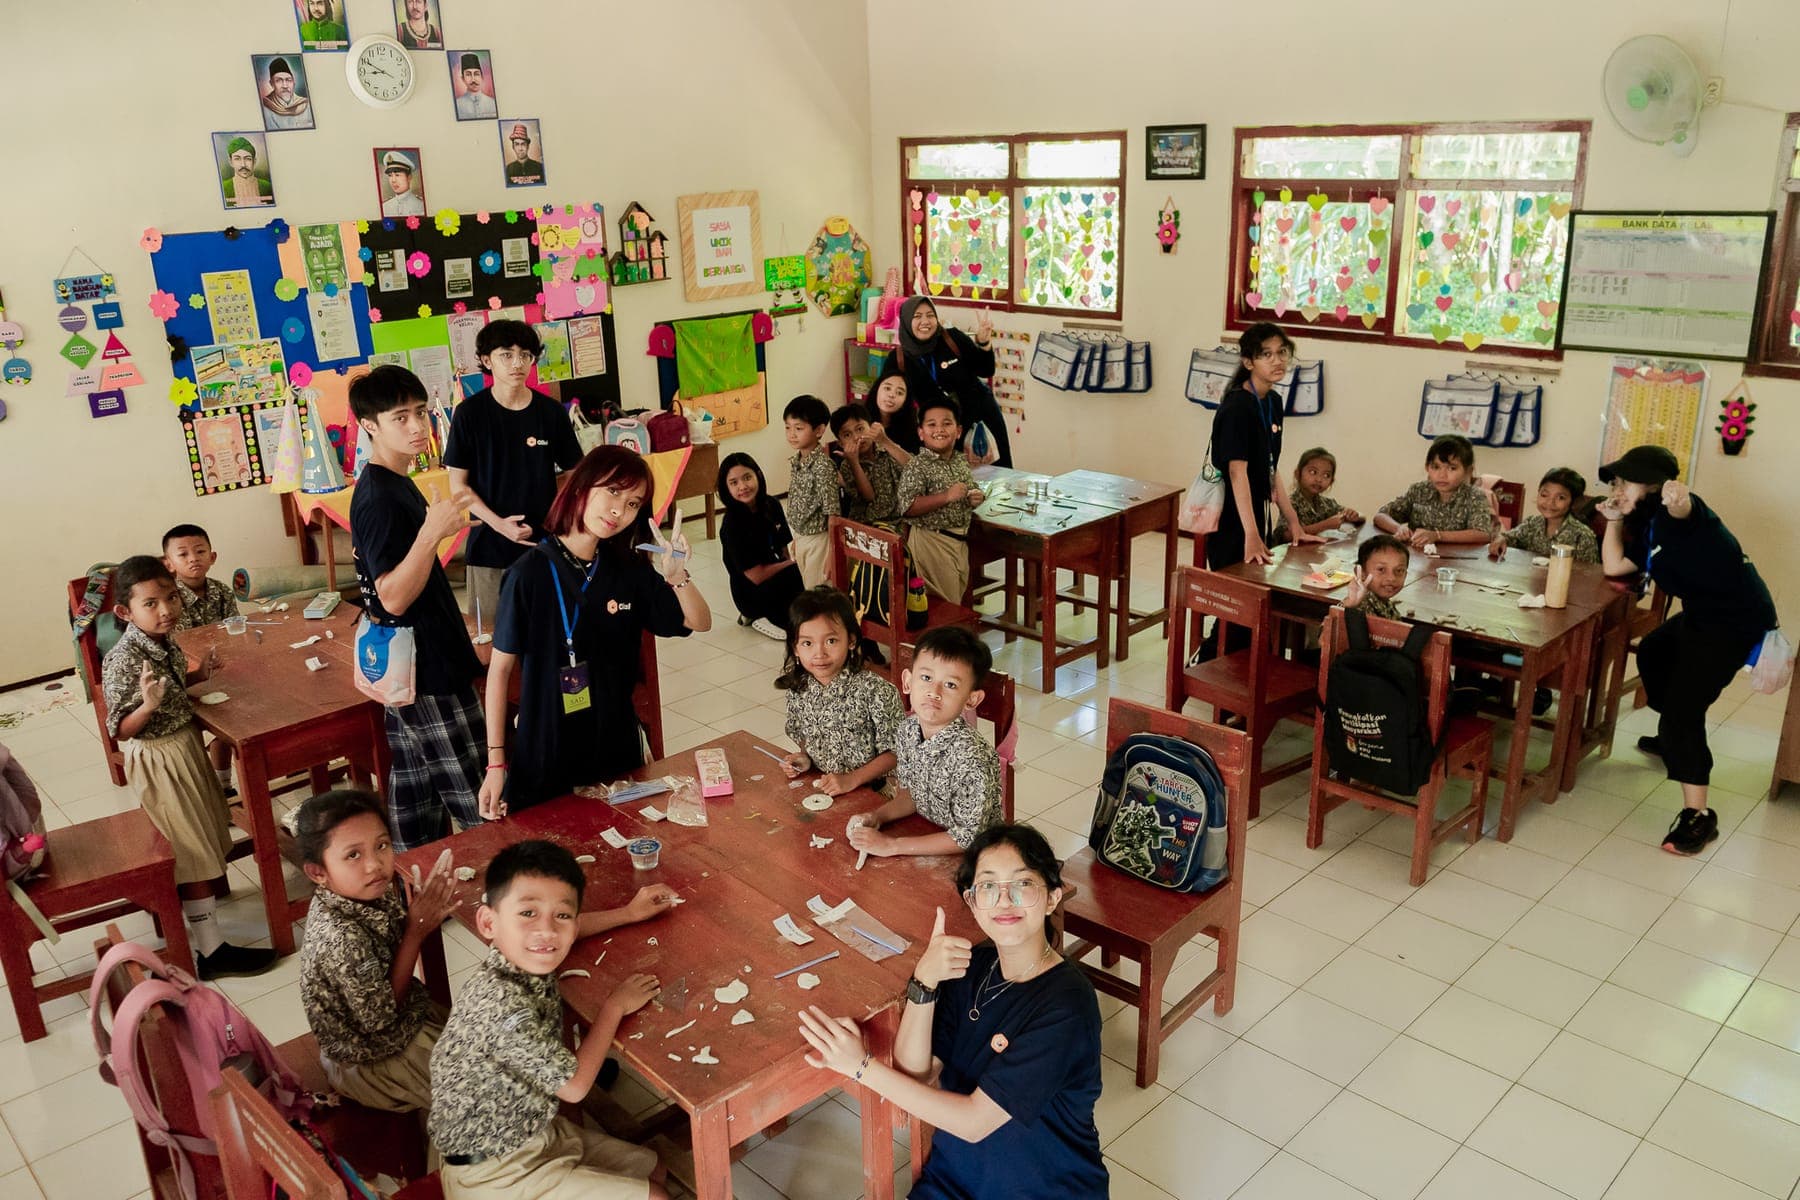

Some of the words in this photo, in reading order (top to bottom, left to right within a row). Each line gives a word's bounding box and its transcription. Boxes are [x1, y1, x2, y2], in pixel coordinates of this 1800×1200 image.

[709, 221, 731, 232] SAYA
[1622, 220, 1649, 228] BANK
[1652, 220, 1677, 228] DATA
[710, 237, 731, 247] UNIK
[715, 248, 732, 257] DAN
[703, 263, 746, 277] BERHARGA
[1161, 777, 1189, 792] TARGET
[1156, 784, 1192, 803] HUNTER
[1182, 819, 1199, 827] SHOT
[1171, 837, 1187, 848] THIS
[1162, 848, 1181, 862] WAY
